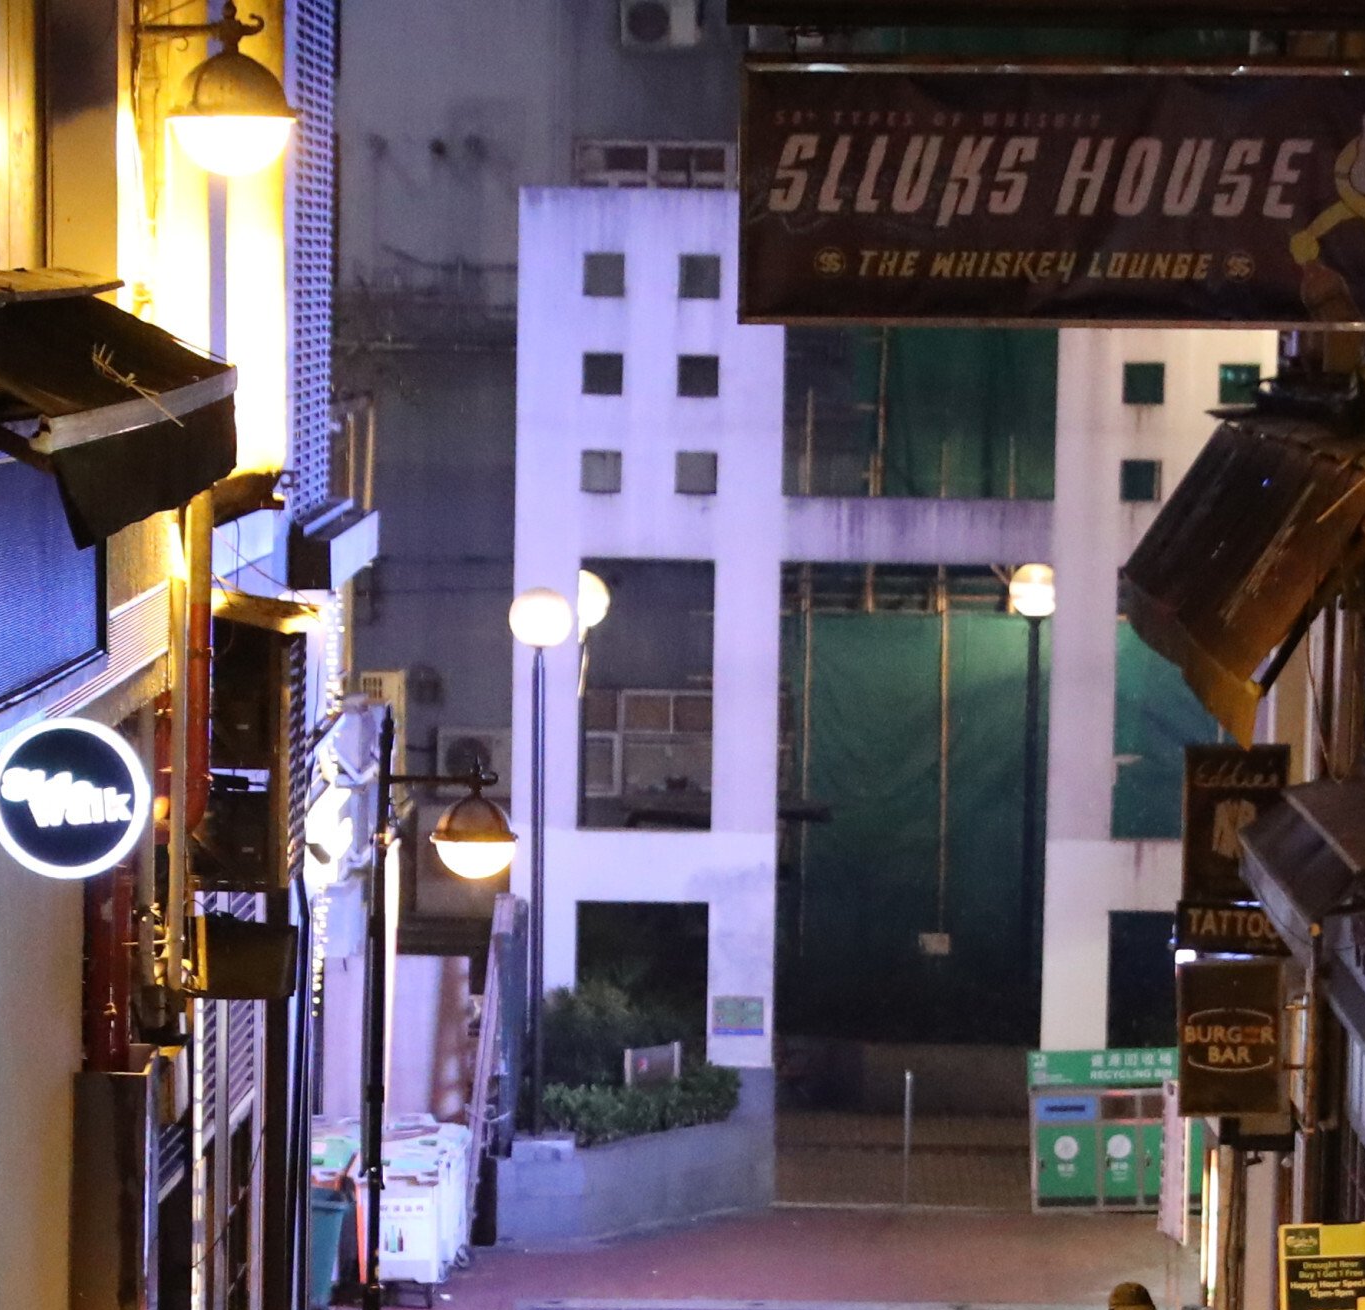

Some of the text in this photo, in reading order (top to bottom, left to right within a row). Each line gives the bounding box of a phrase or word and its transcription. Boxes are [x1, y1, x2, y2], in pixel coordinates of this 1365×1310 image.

[1055, 136, 1315, 220] HOUSE
[858, 249, 921, 278] THE
[928, 250, 1077, 284] WHISKEY
[1086, 251, 1213, 279] LOUNGE
[1208, 1045, 1251, 1064] BAR
[1090, 1069, 1152, 1080] RECYCLING
[1290, 1281, 1318, 1291] Happy
[1319, 1280, 1341, 1288] Hour
